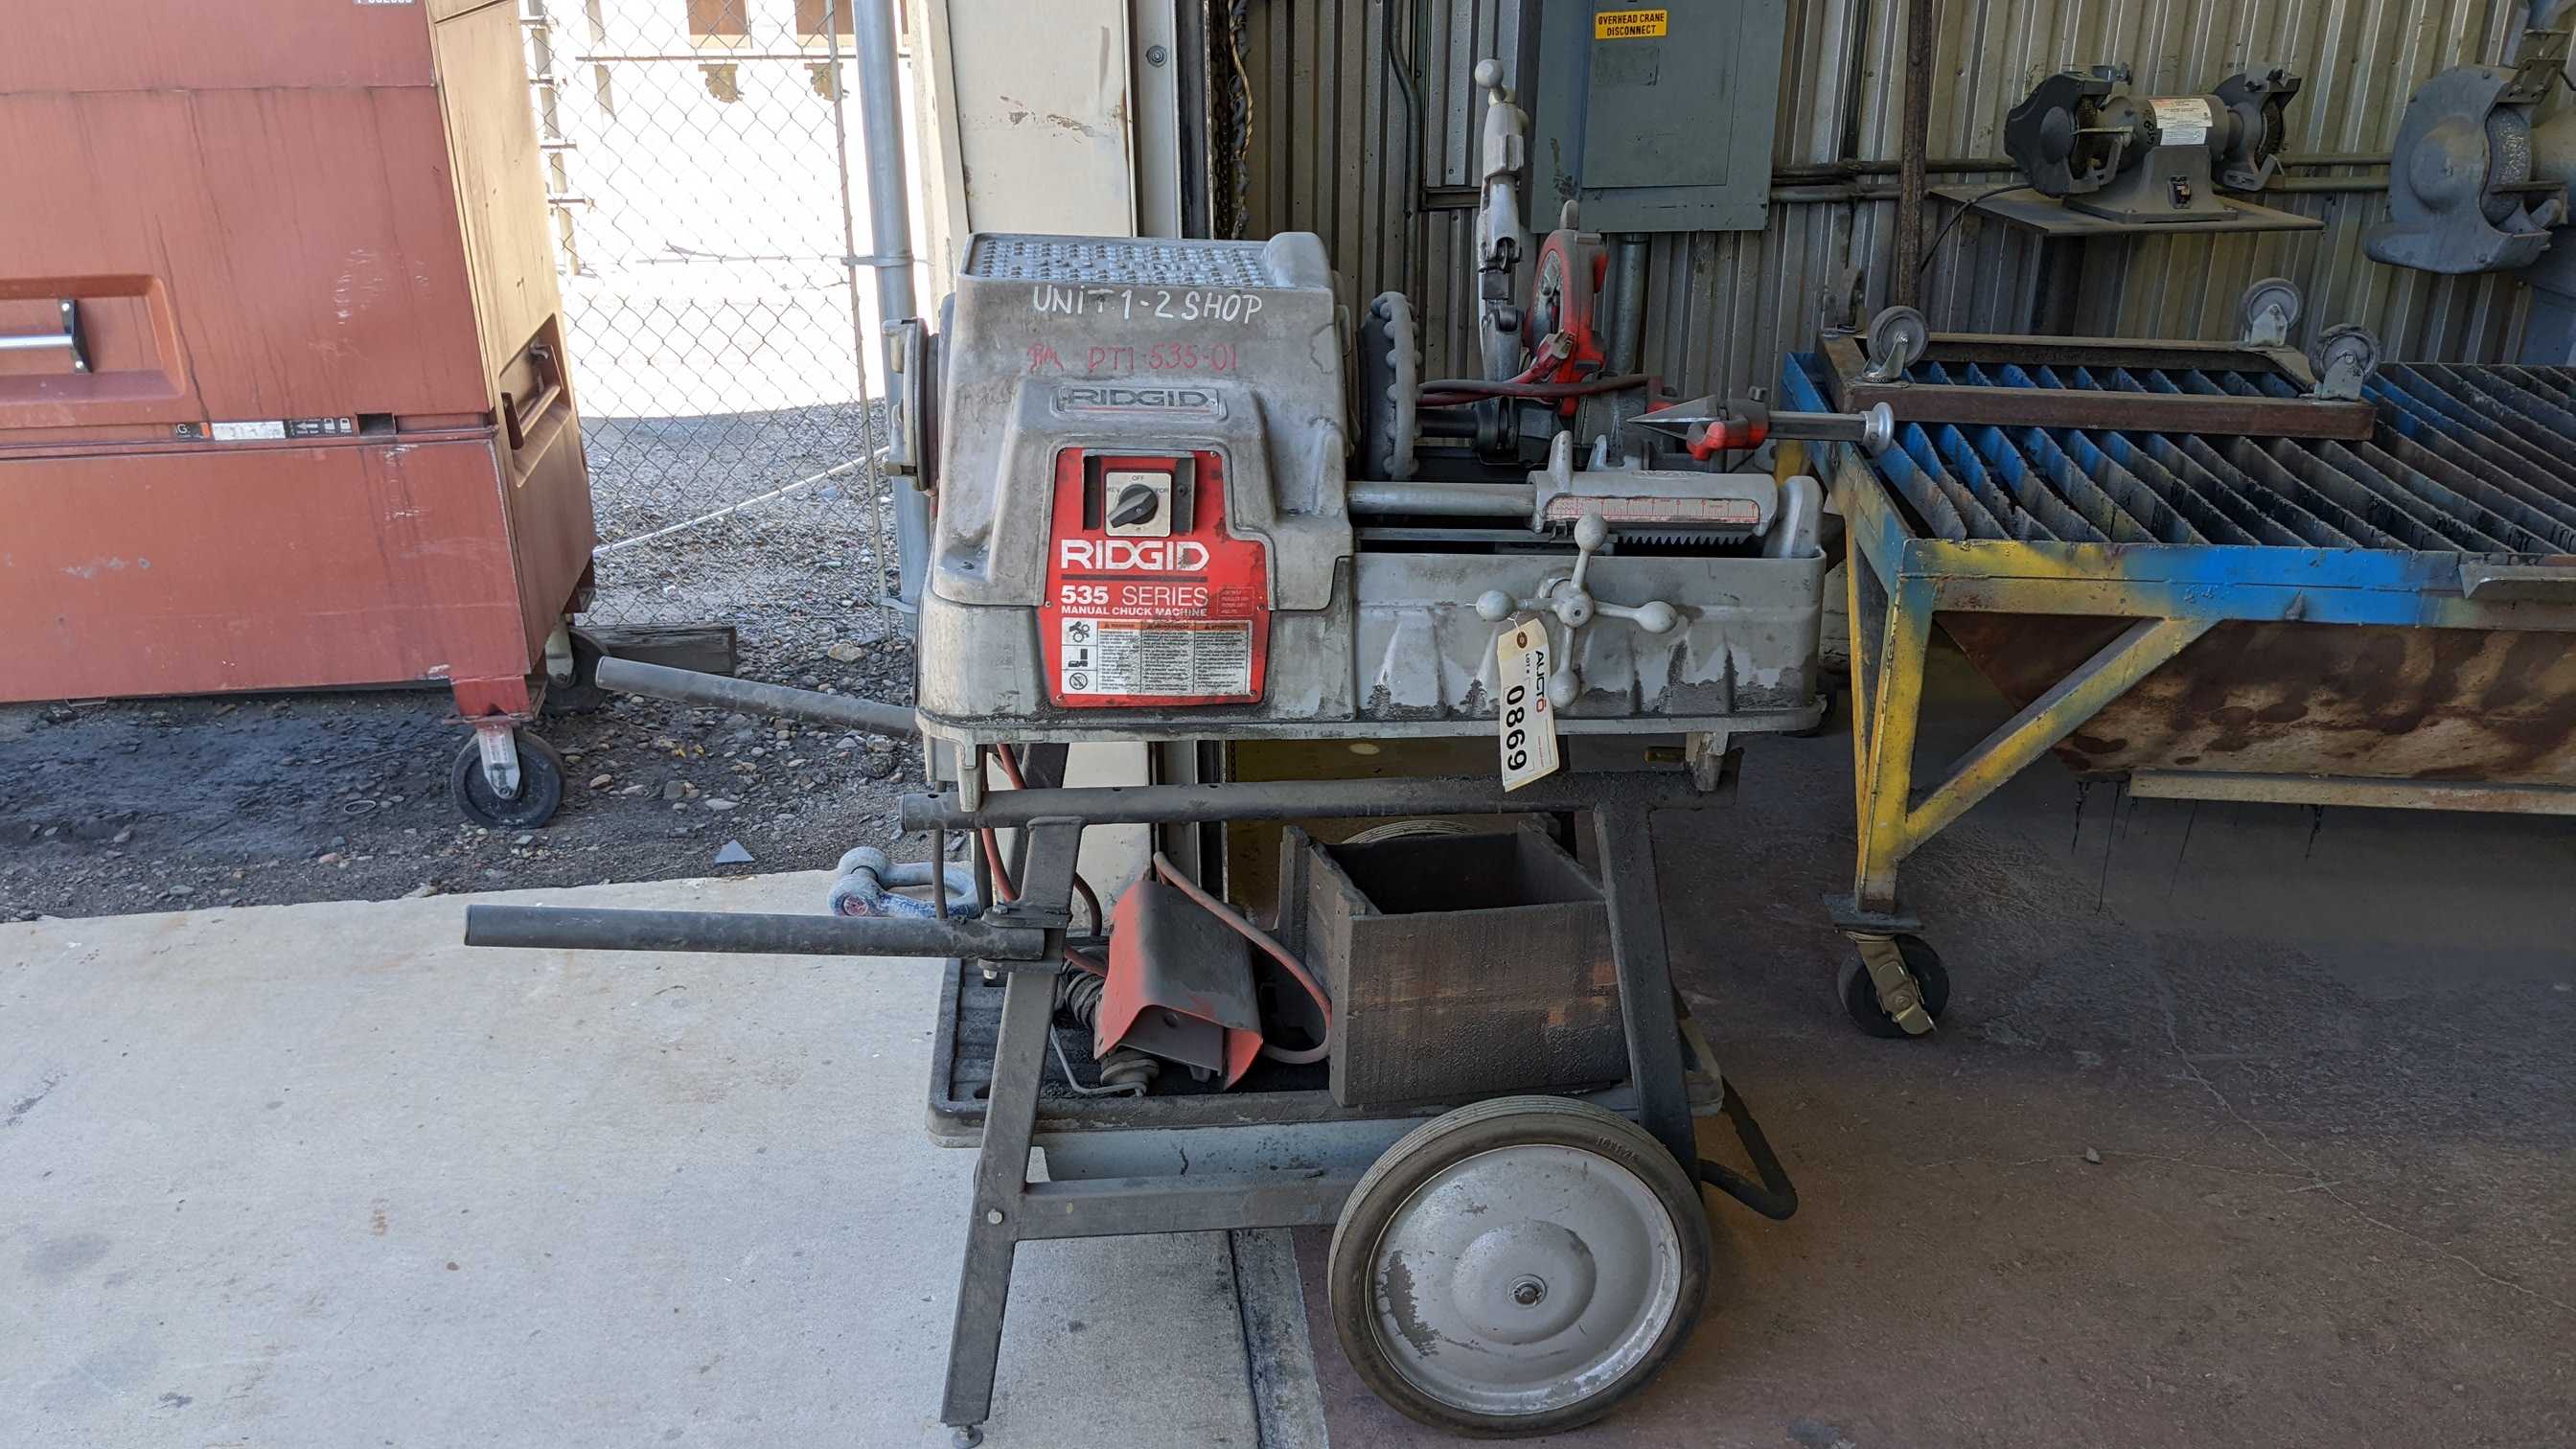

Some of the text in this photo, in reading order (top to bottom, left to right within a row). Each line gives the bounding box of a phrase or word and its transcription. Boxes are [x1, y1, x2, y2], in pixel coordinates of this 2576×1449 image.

[1598, 12, 1665, 25] OVERHEAD CRANE
[1607, 25, 1656, 36] DISCONNECT
[1182, 290, 1262, 324] SHOP
[1070, 388, 1209, 407] RIDGID
[1061, 539, 1209, 571] RIDGID
[1061, 585, 1109, 605] 535
[1122, 586, 1208, 607] SERIES
[1061, 606, 1208, 617] MANUAL CHUCK MACHINE
[1506, 684, 1527, 771] 0869
